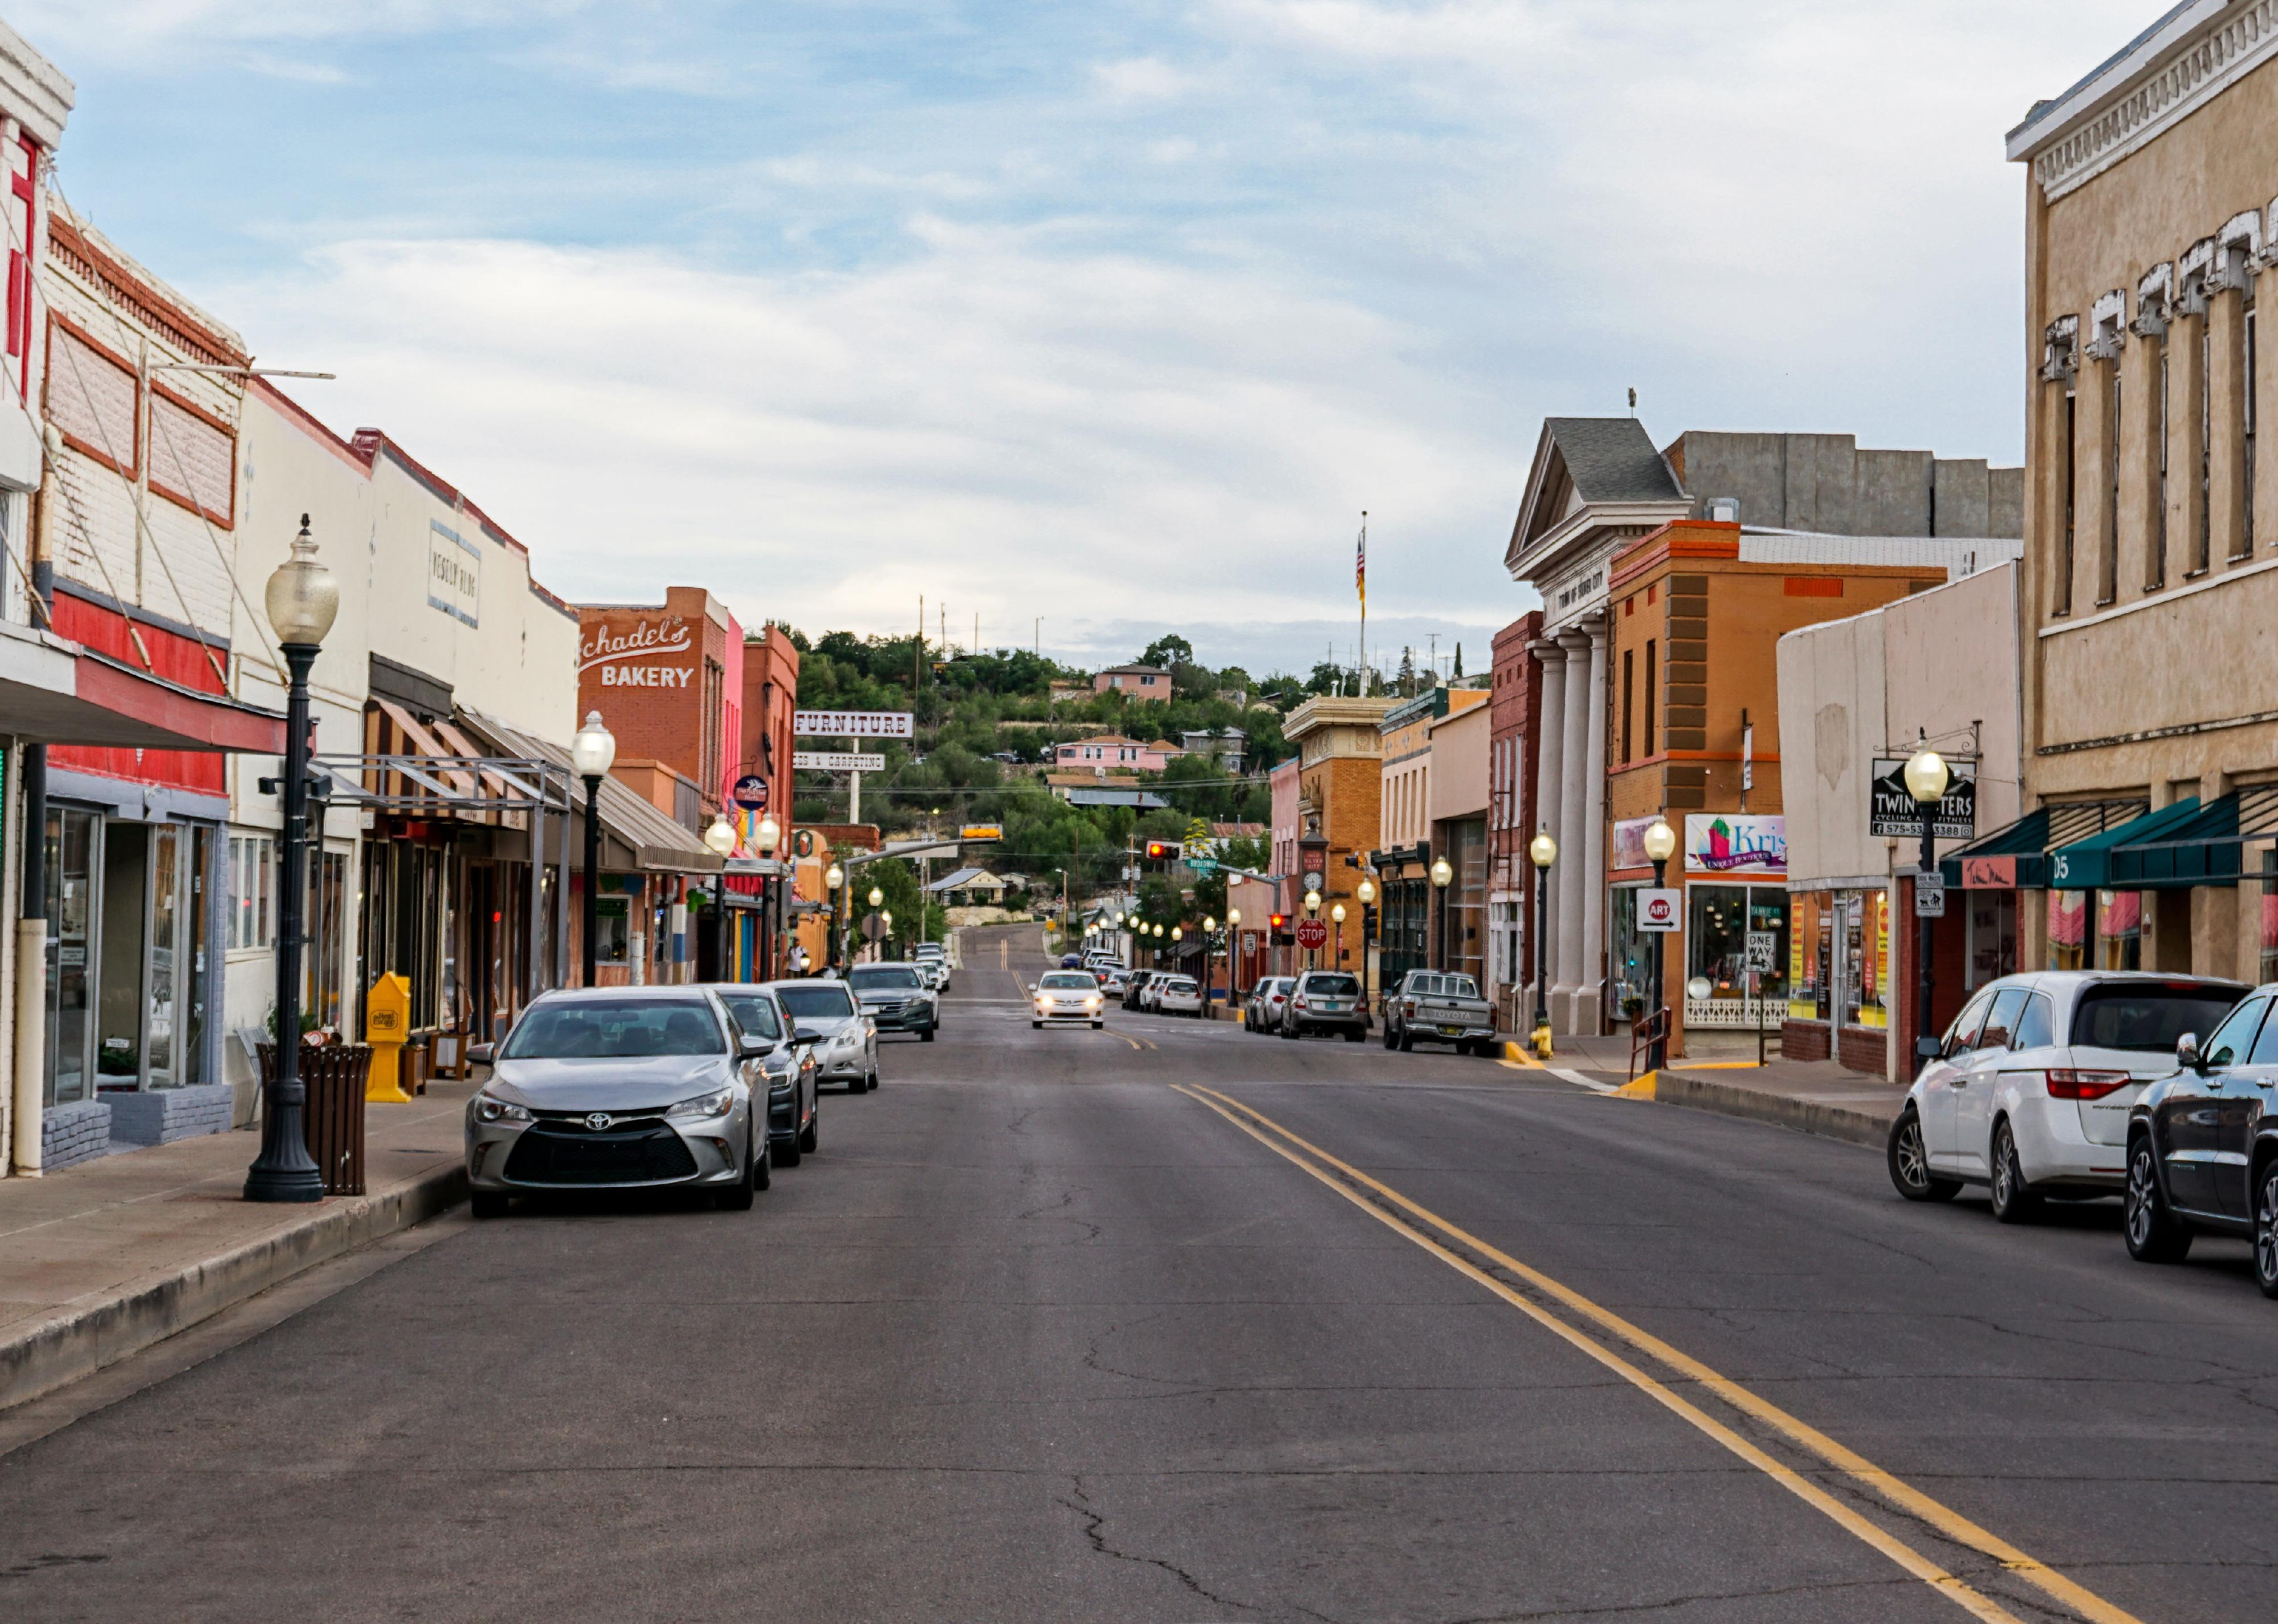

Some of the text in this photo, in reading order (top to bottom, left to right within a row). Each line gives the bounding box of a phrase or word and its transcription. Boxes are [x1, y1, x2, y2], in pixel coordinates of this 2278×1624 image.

[602, 666, 694, 688] BAKERY
[796, 713, 905, 734] FURNITURE
[829, 756, 881, 768] CARPETING
[1876, 793, 1972, 816] TWIN TERS
[1886, 825, 1959, 836] 575-533388
[1190, 859, 1217, 869] BROADWAY
[1650, 905, 1669, 915] ART
[1299, 928, 1325, 941] STOP
[1750, 936, 1771, 946] ONE
[1749, 946, 1771, 957] WAY
[1432, 1009, 1471, 1019] TOYOTA
